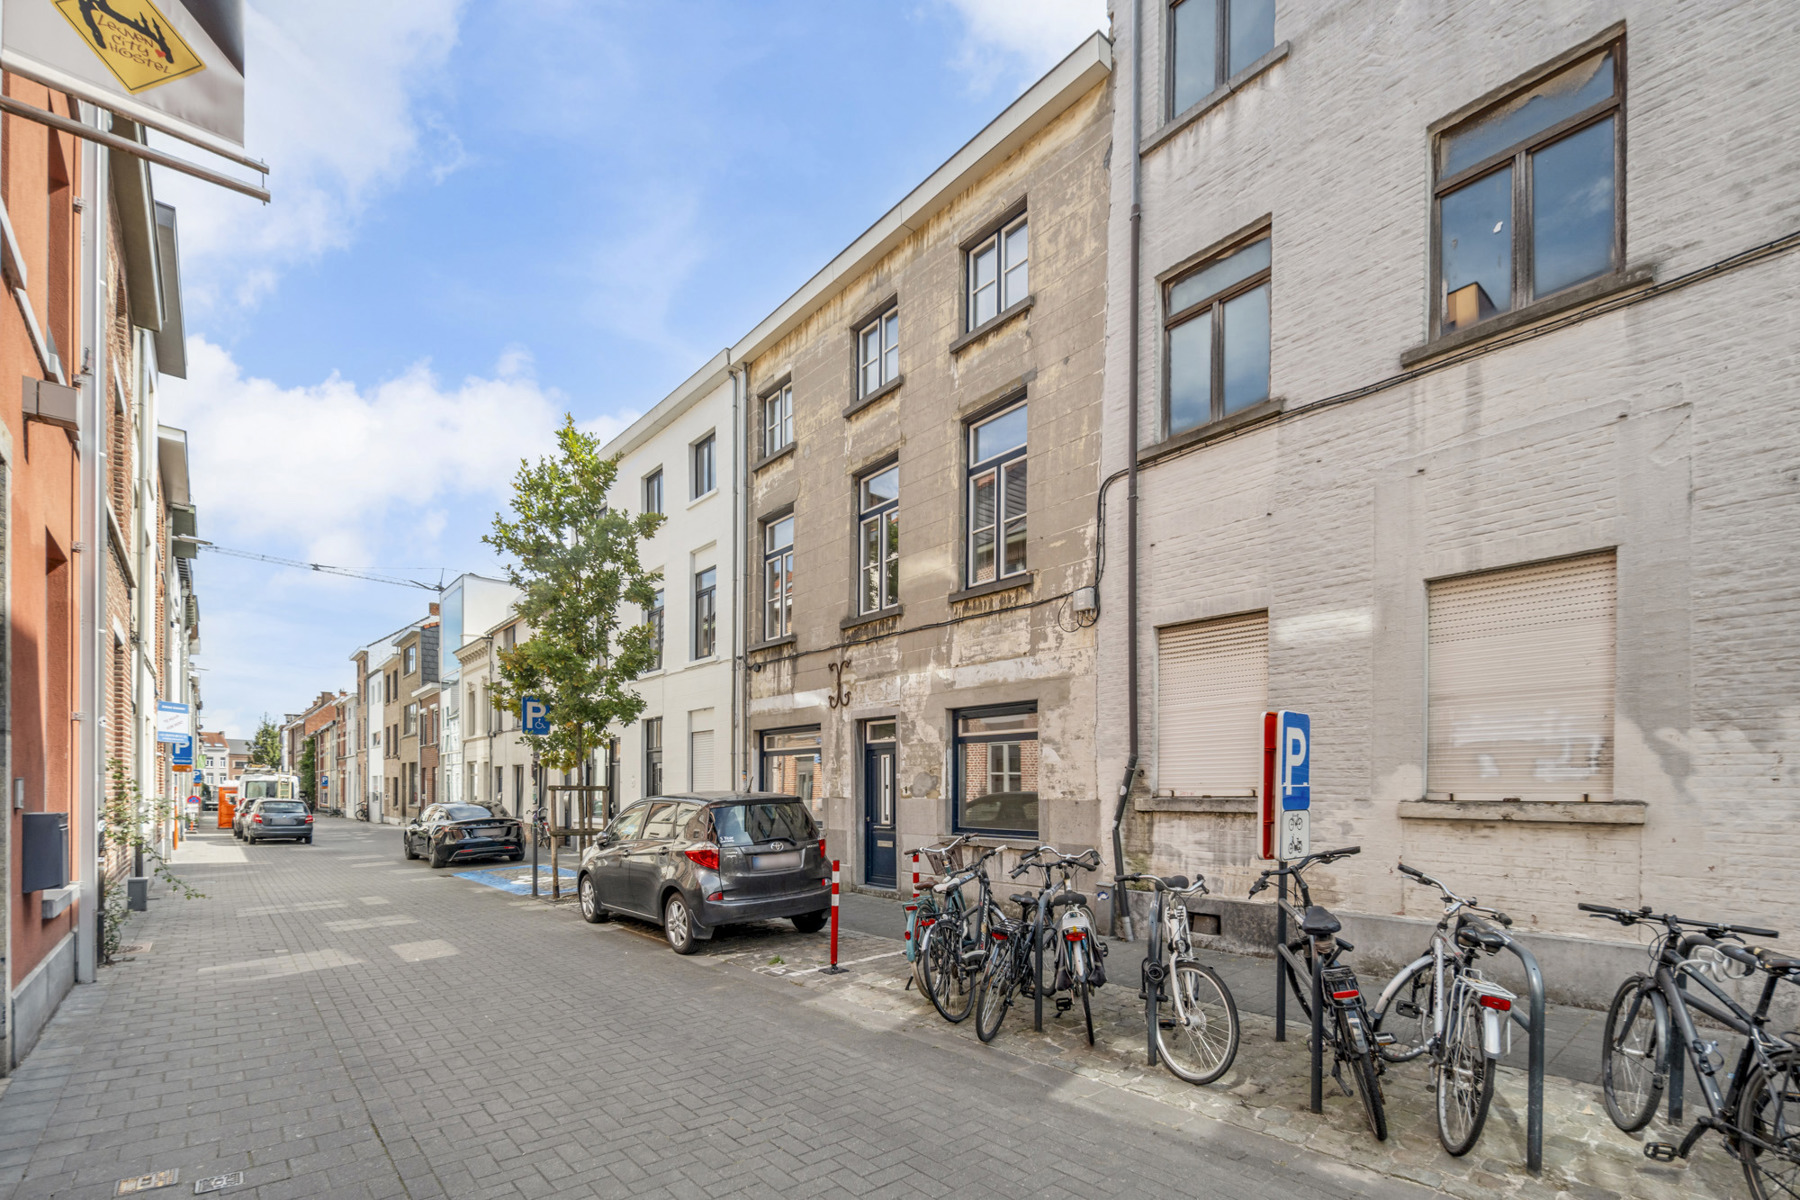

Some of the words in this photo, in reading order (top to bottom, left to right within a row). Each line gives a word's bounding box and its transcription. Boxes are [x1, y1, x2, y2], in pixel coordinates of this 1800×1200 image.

[112, 34, 149, 57] City
[526, 701, 546, 729] P
[1285, 726, 1307, 796] P
